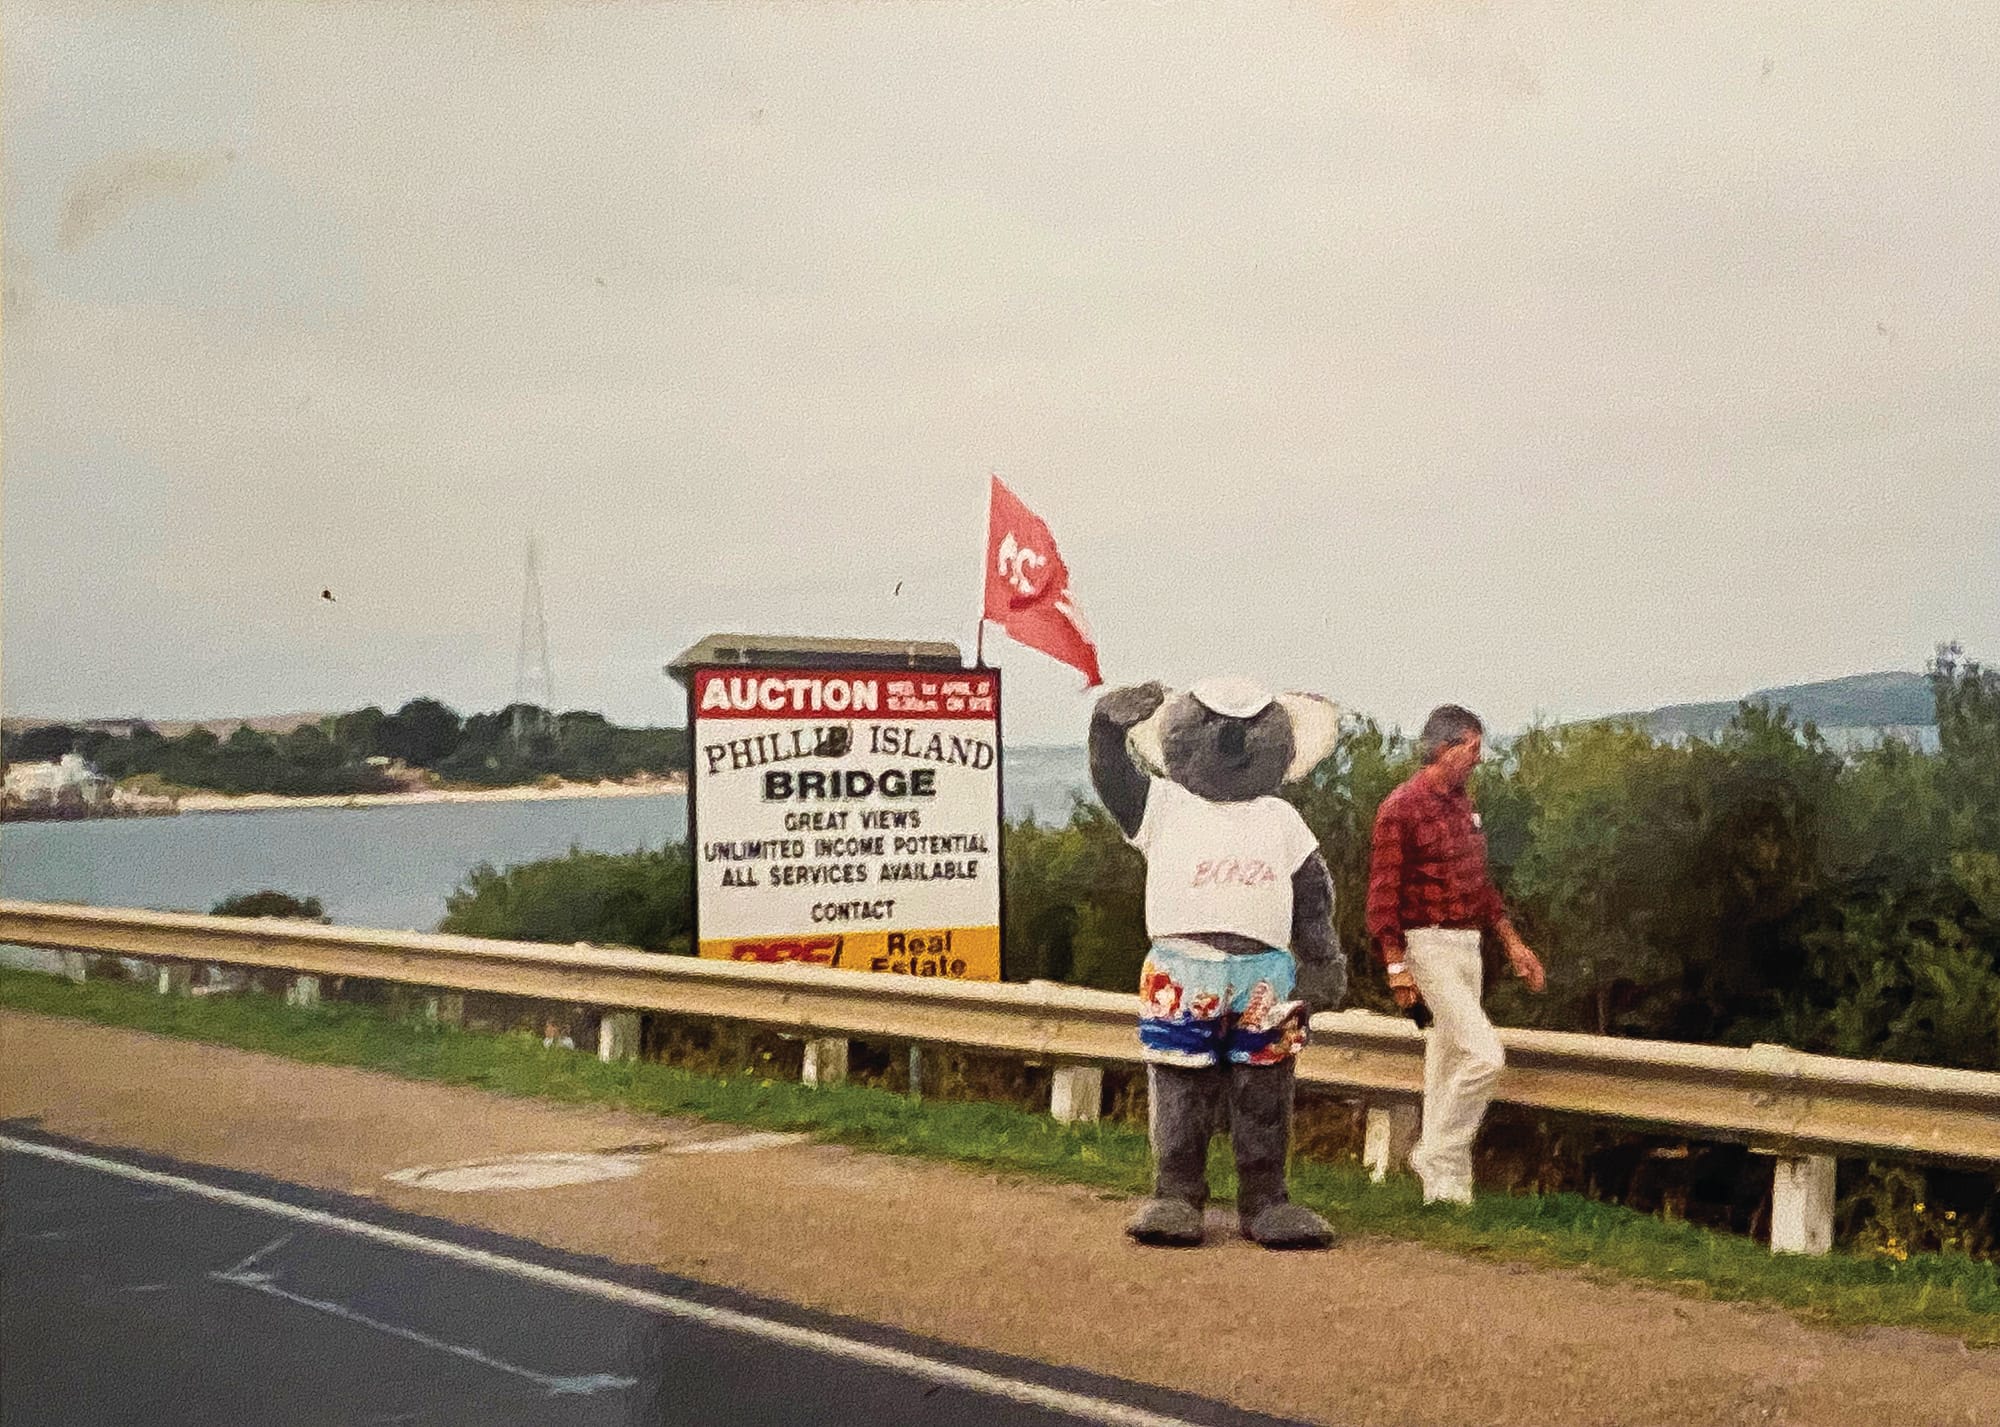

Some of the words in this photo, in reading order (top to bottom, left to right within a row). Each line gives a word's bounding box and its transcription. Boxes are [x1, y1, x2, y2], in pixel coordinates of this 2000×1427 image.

[701, 676, 879, 711] AUCTION
[869, 725, 994, 770] ISLAND
[764, 768, 937, 800] BRIDGE
[784, 811, 849, 831] GREAT
[861, 809, 922, 830] VIEWS
[704, 839, 805, 862] UNLIMITED
[815, 836, 885, 858] INCOME
[894, 834, 989, 854] POTENTIAL
[721, 866, 760, 887] ALL
[769, 863, 868, 888] SERVICES
[879, 860, 978, 881] AVAILABLE
[811, 900, 895, 923] CONTACT
[887, 930, 953, 956] Real
